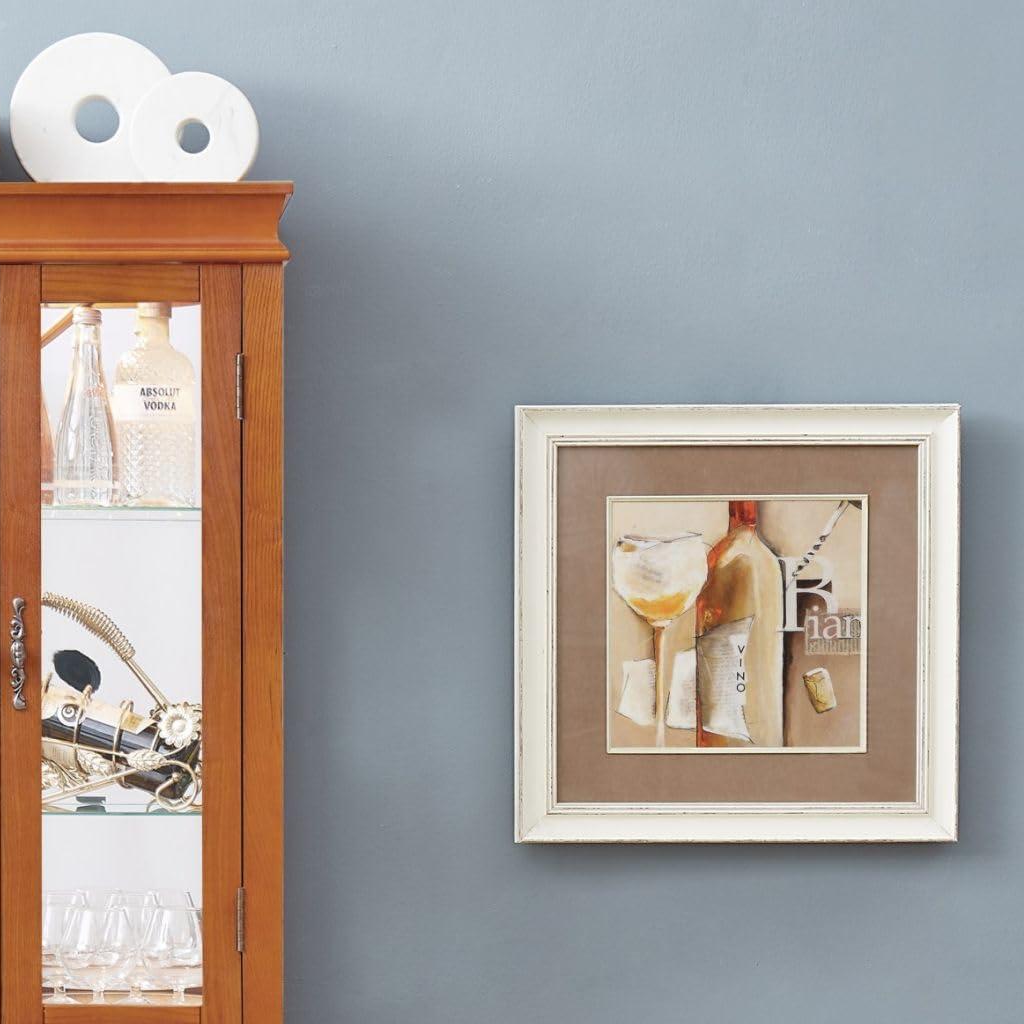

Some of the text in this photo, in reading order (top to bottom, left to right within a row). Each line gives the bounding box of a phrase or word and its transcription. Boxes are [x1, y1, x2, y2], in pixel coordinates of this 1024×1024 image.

[140, 387, 180, 398] ABSOLUT
[144, 400, 176, 411] VODKA
[736, 645, 746, 693] VINO
